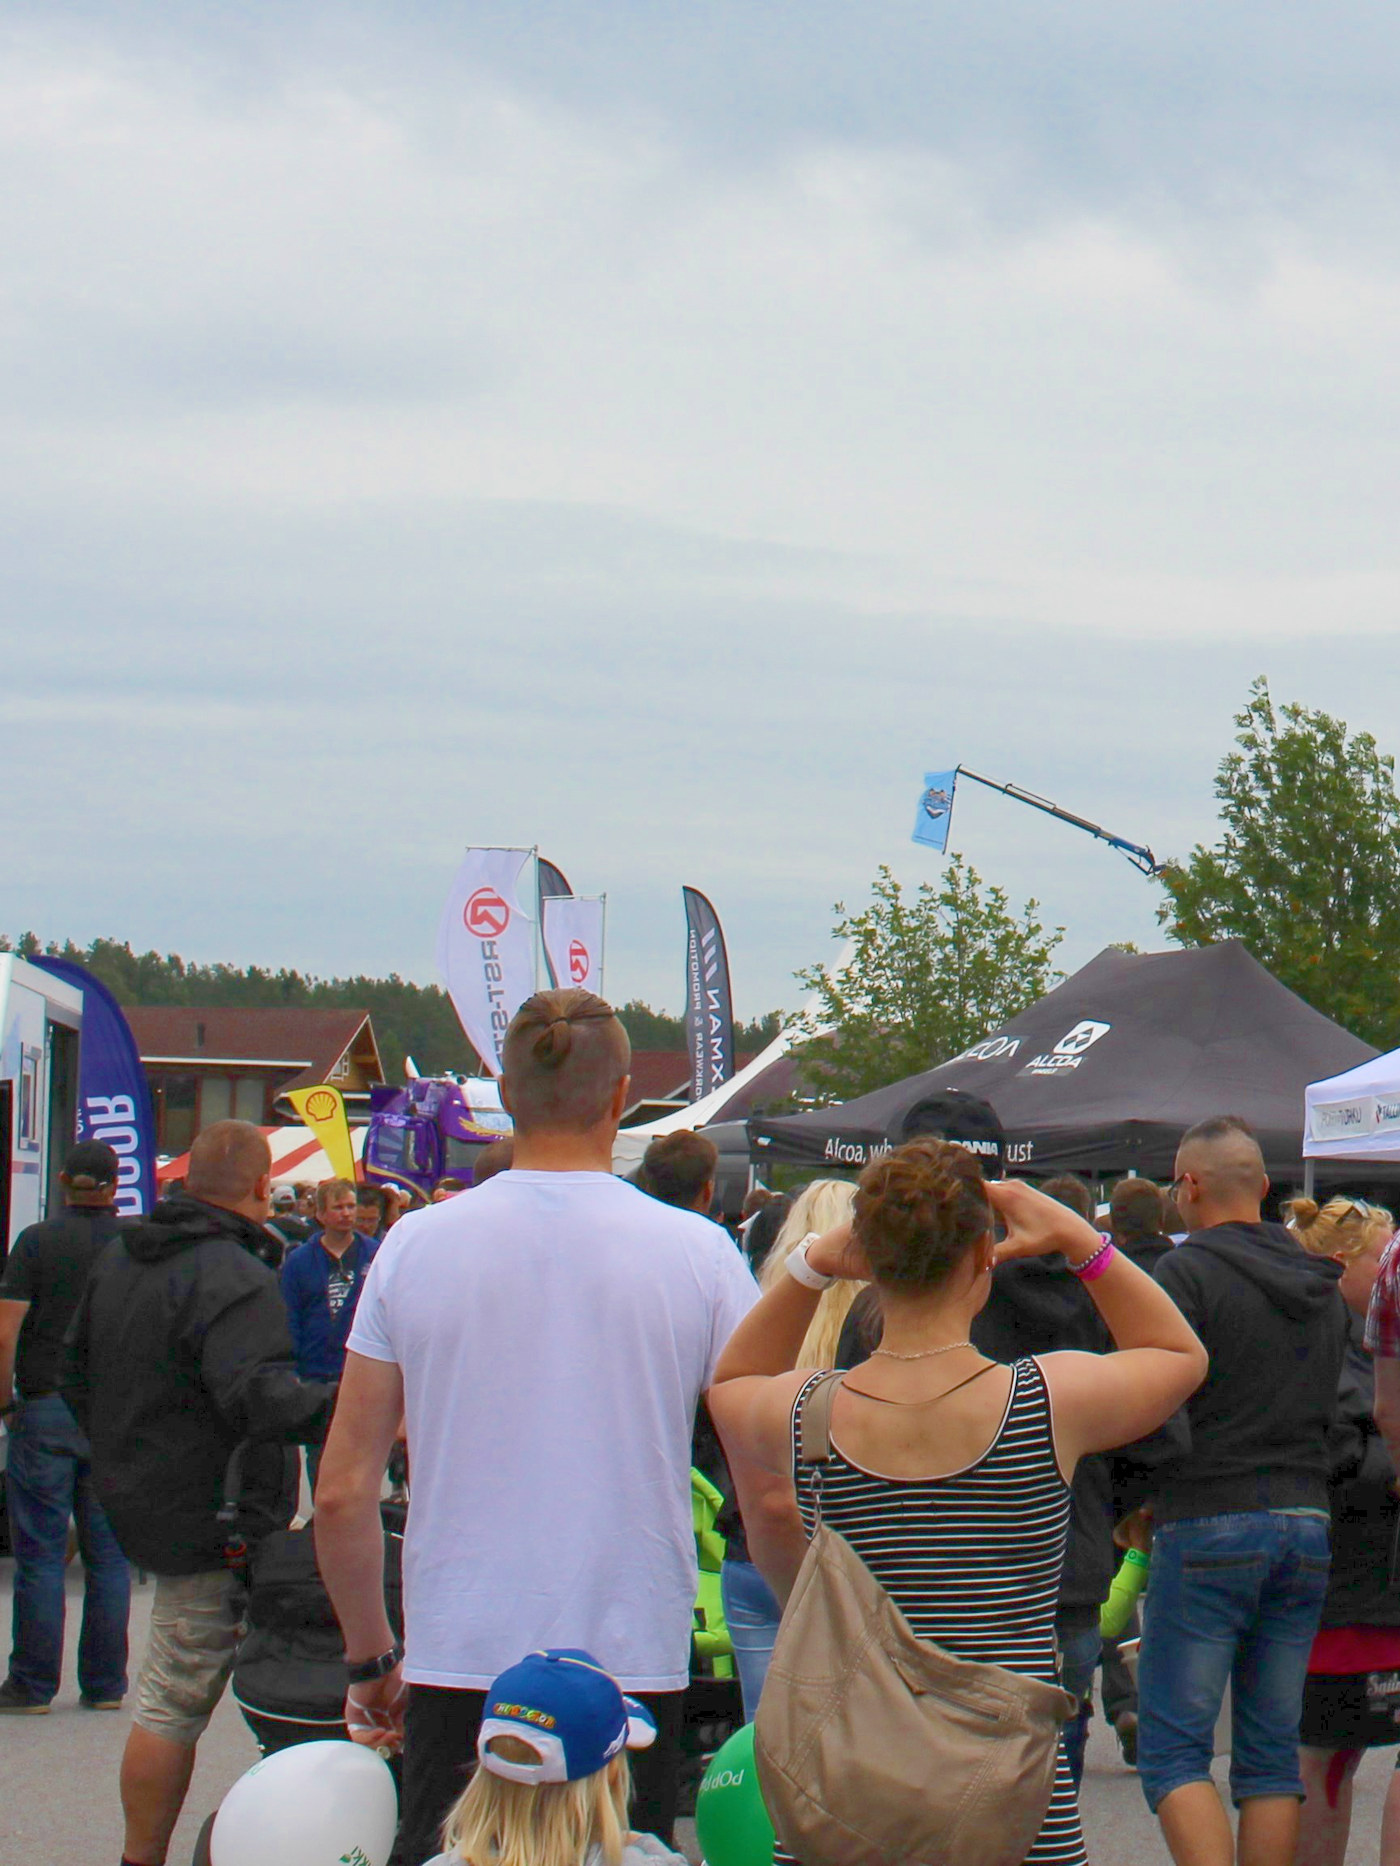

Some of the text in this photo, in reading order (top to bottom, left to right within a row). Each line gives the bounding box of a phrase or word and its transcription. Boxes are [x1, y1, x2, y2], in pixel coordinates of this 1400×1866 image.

[1024, 1054, 1083, 1069] ALCOA
[824, 1137, 1034, 1165] Alcoa, wh ust
[949, 1140, 1000, 1157] ANIA
